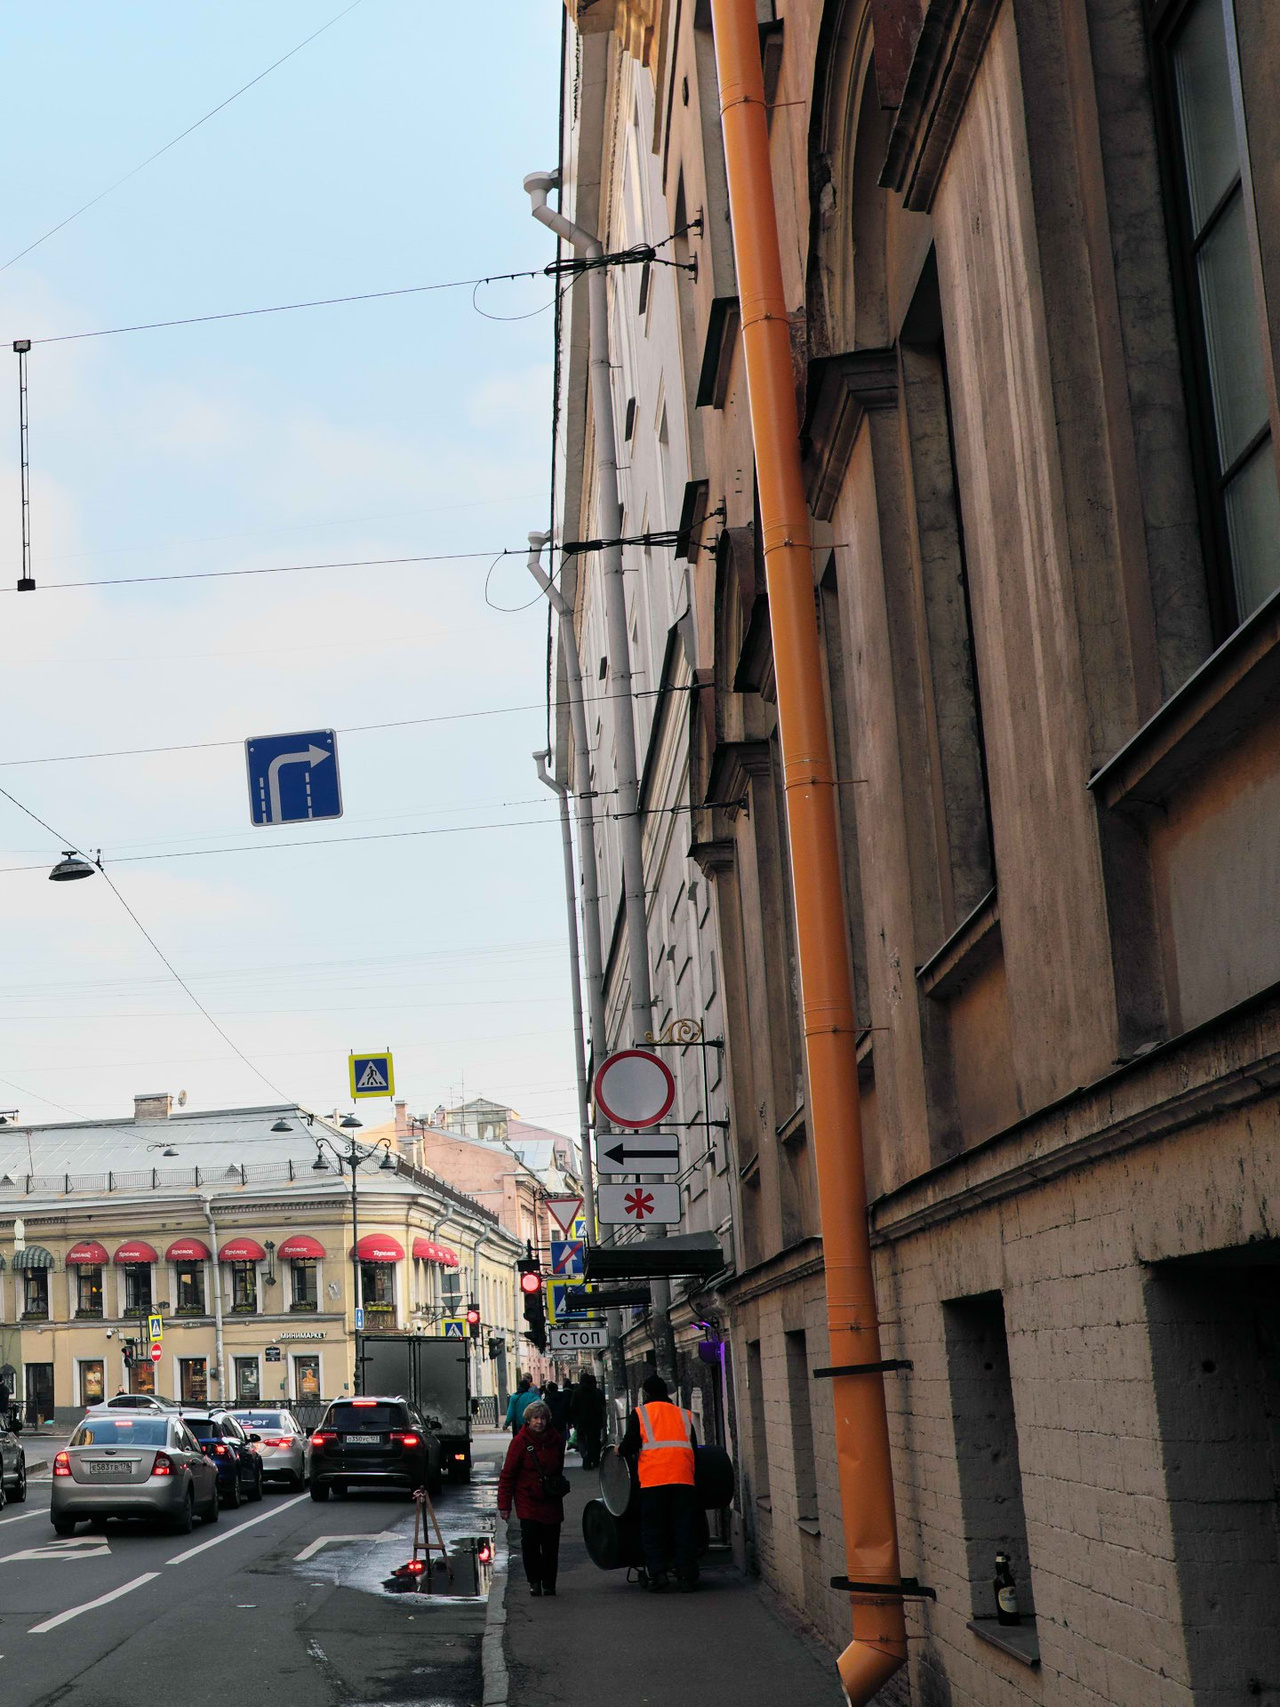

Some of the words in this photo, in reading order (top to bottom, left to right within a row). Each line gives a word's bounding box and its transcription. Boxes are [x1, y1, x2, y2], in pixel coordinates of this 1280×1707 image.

[280, 1331, 327, 1339] МИНИМАРКЕТ
[559, 1331, 600, 1346] СТОП
[237, 1418, 270, 1426] ber
